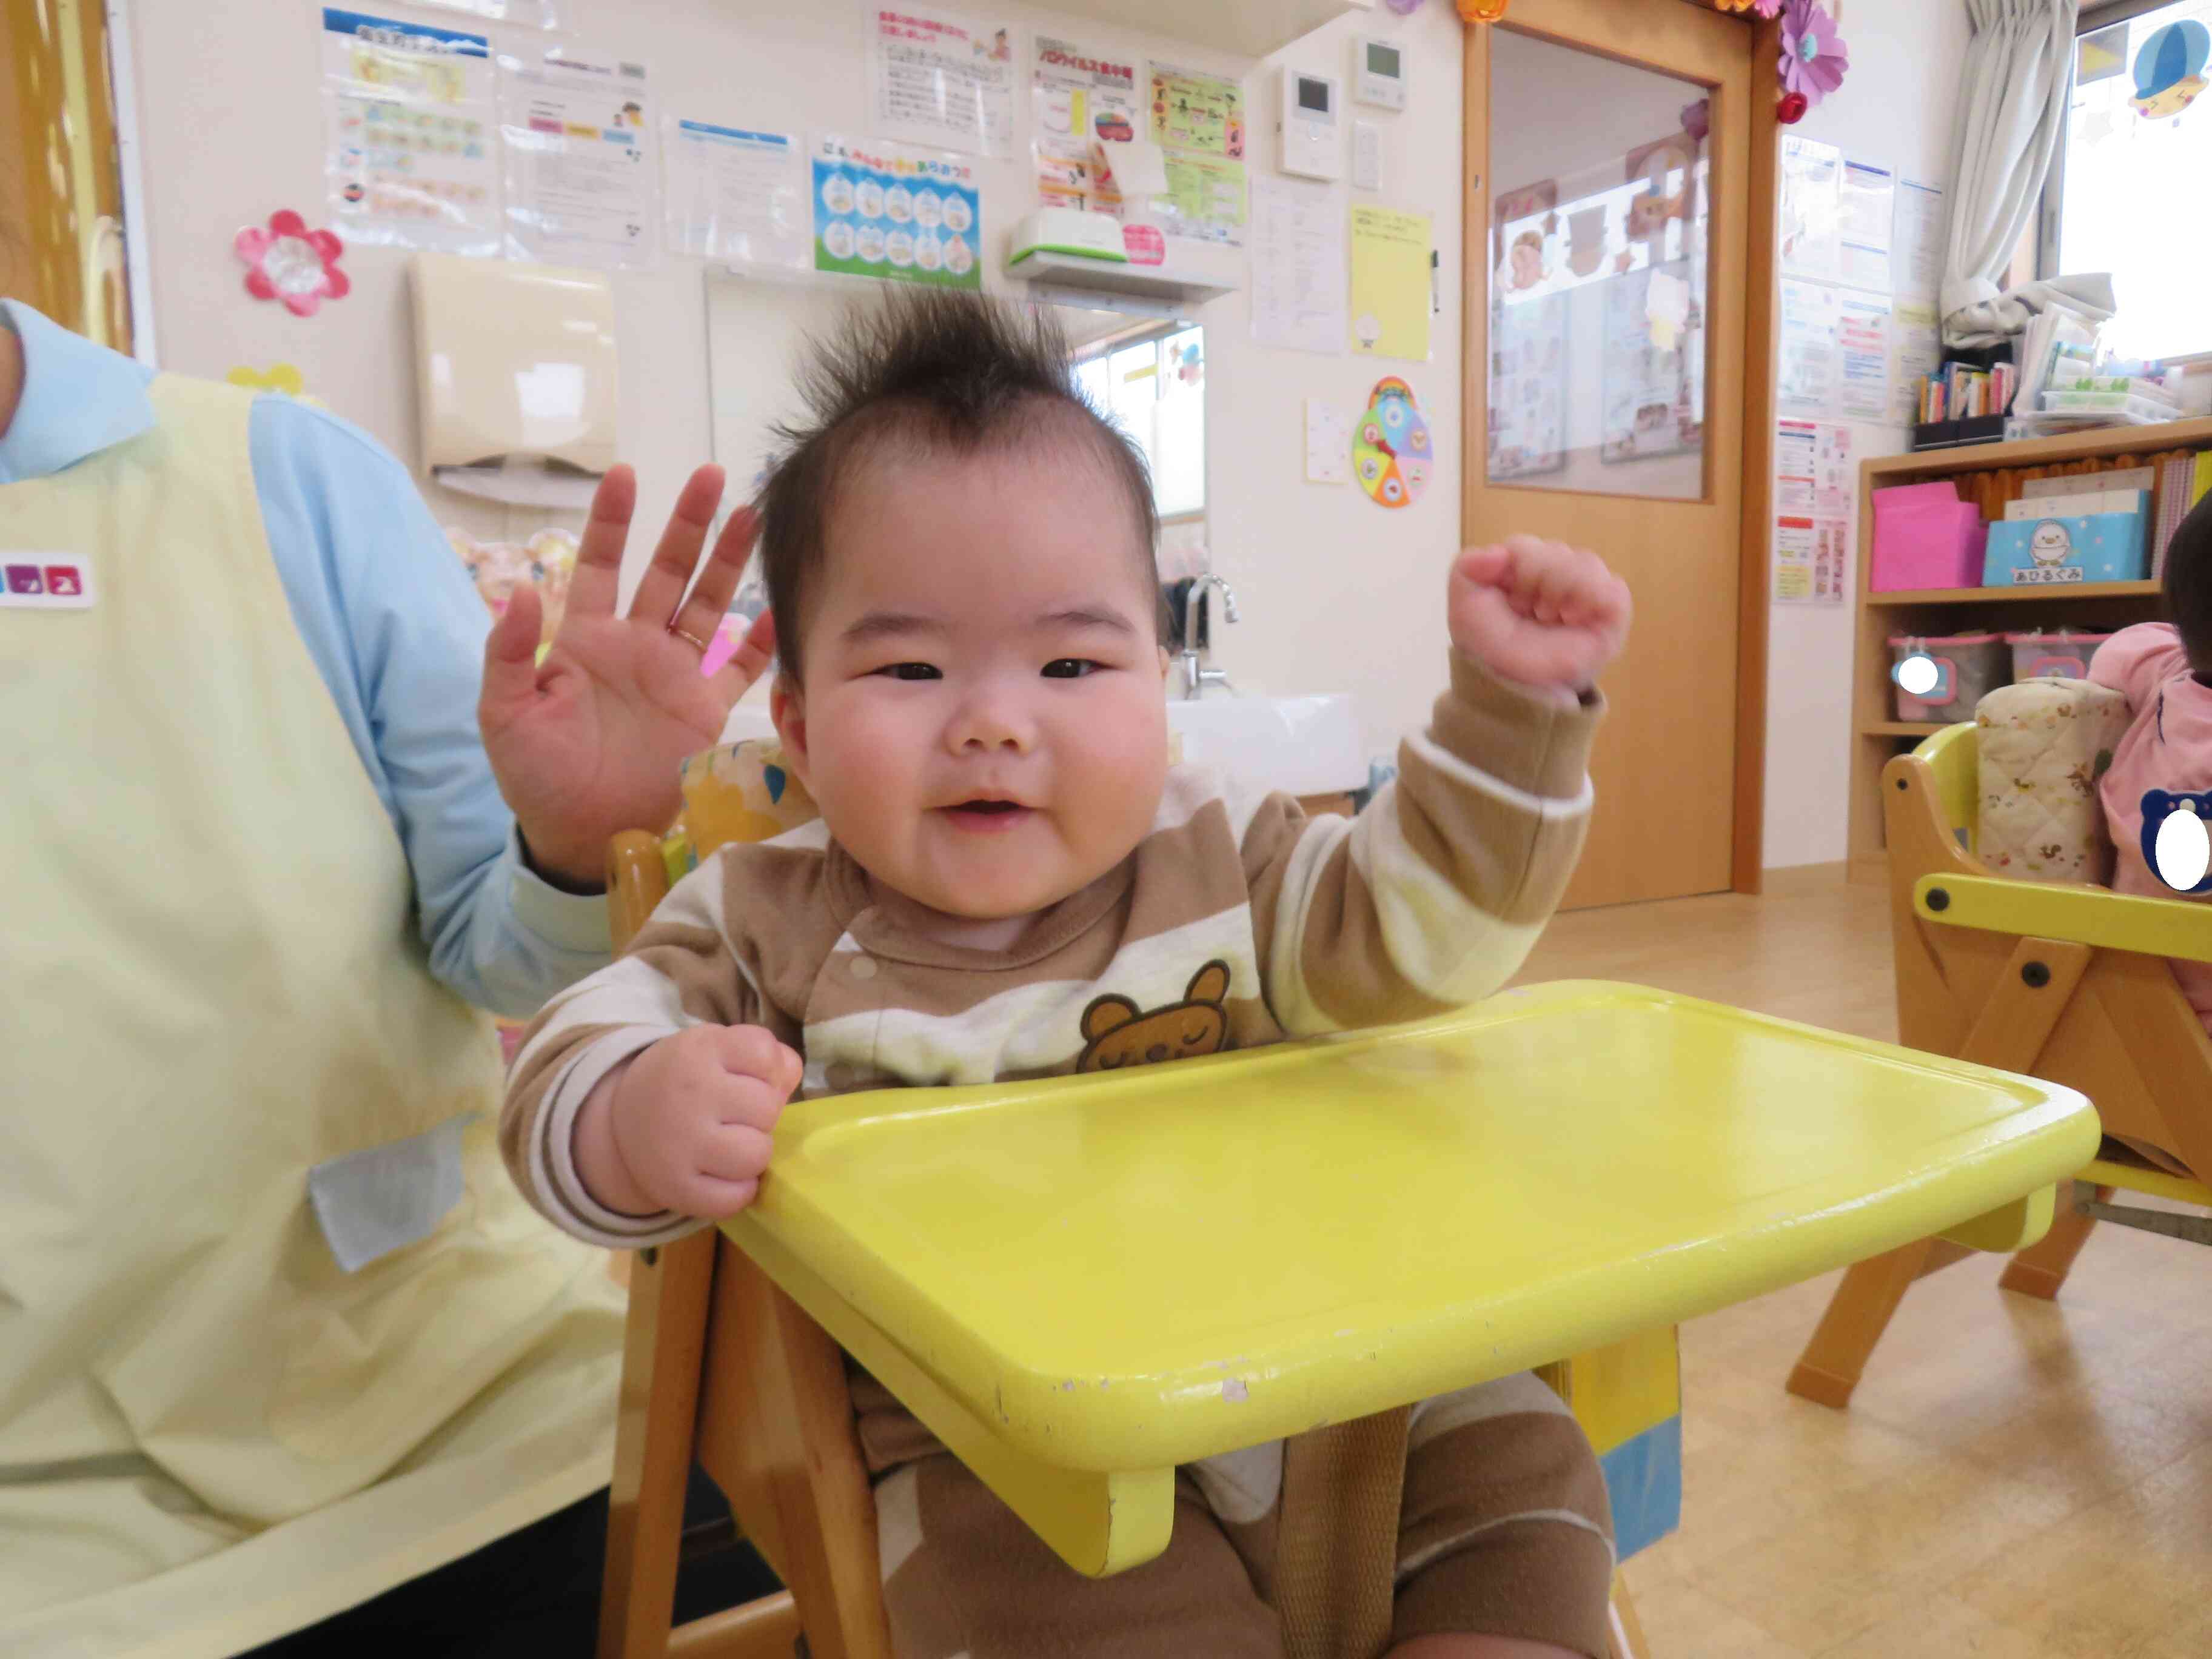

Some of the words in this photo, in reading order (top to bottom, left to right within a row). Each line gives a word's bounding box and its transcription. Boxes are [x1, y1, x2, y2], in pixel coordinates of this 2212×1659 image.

[2016, 568, 2080, 581] あひるぐみ
